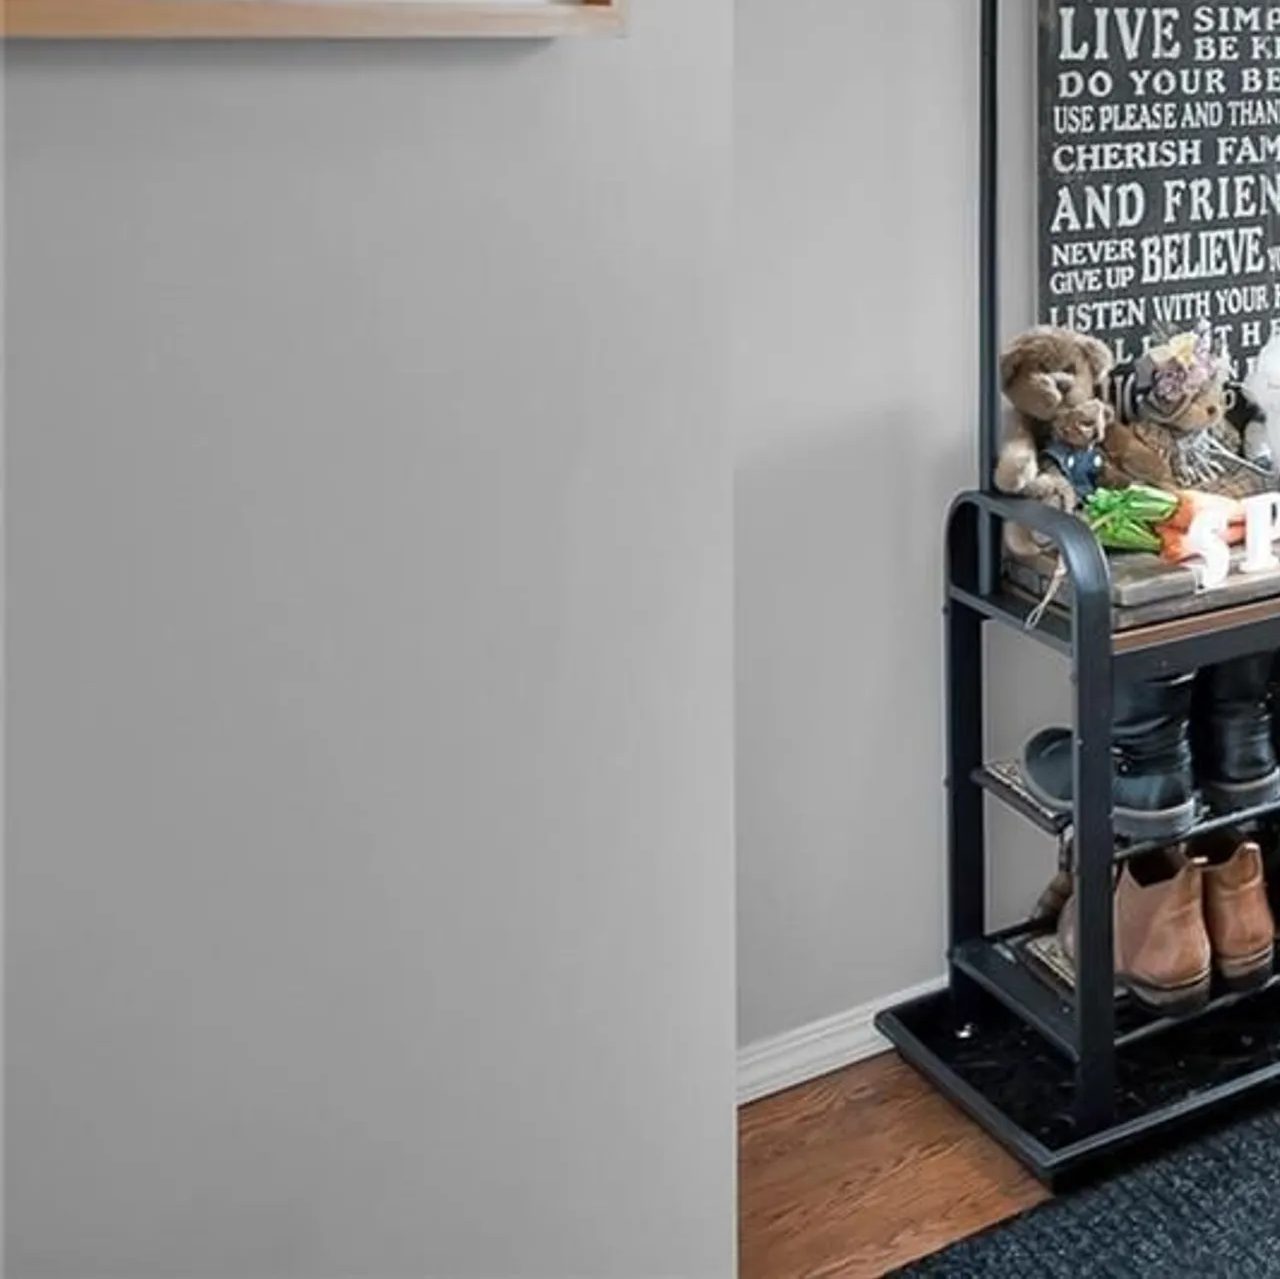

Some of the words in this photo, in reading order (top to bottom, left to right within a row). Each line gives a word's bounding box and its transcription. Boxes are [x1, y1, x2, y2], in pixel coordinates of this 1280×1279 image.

[1058, 6, 1181, 61] LIVE
[1193, 35, 1240, 62] BE
[1058, 71, 1113, 99] DO
[1129, 69, 1226, 96] YOUR
[1053, 105, 1095, 134] USE
[1099, 102, 1177, 131] PLEASE
[1180, 100, 1223, 128] AND
[1052, 138, 1202, 174] CHERISH
[1049, 181, 1145, 233] AND
[1051, 237, 1137, 268] NEVER
[1140, 226, 1265, 284] BELIEVE
[1049, 269, 1103, 296] GIVE
[1105, 266, 1135, 290] UP
[1049, 297, 1147, 333] LISTEN
[1152, 289, 1211, 322] WITH
[1214, 285, 1270, 316] YOUR
